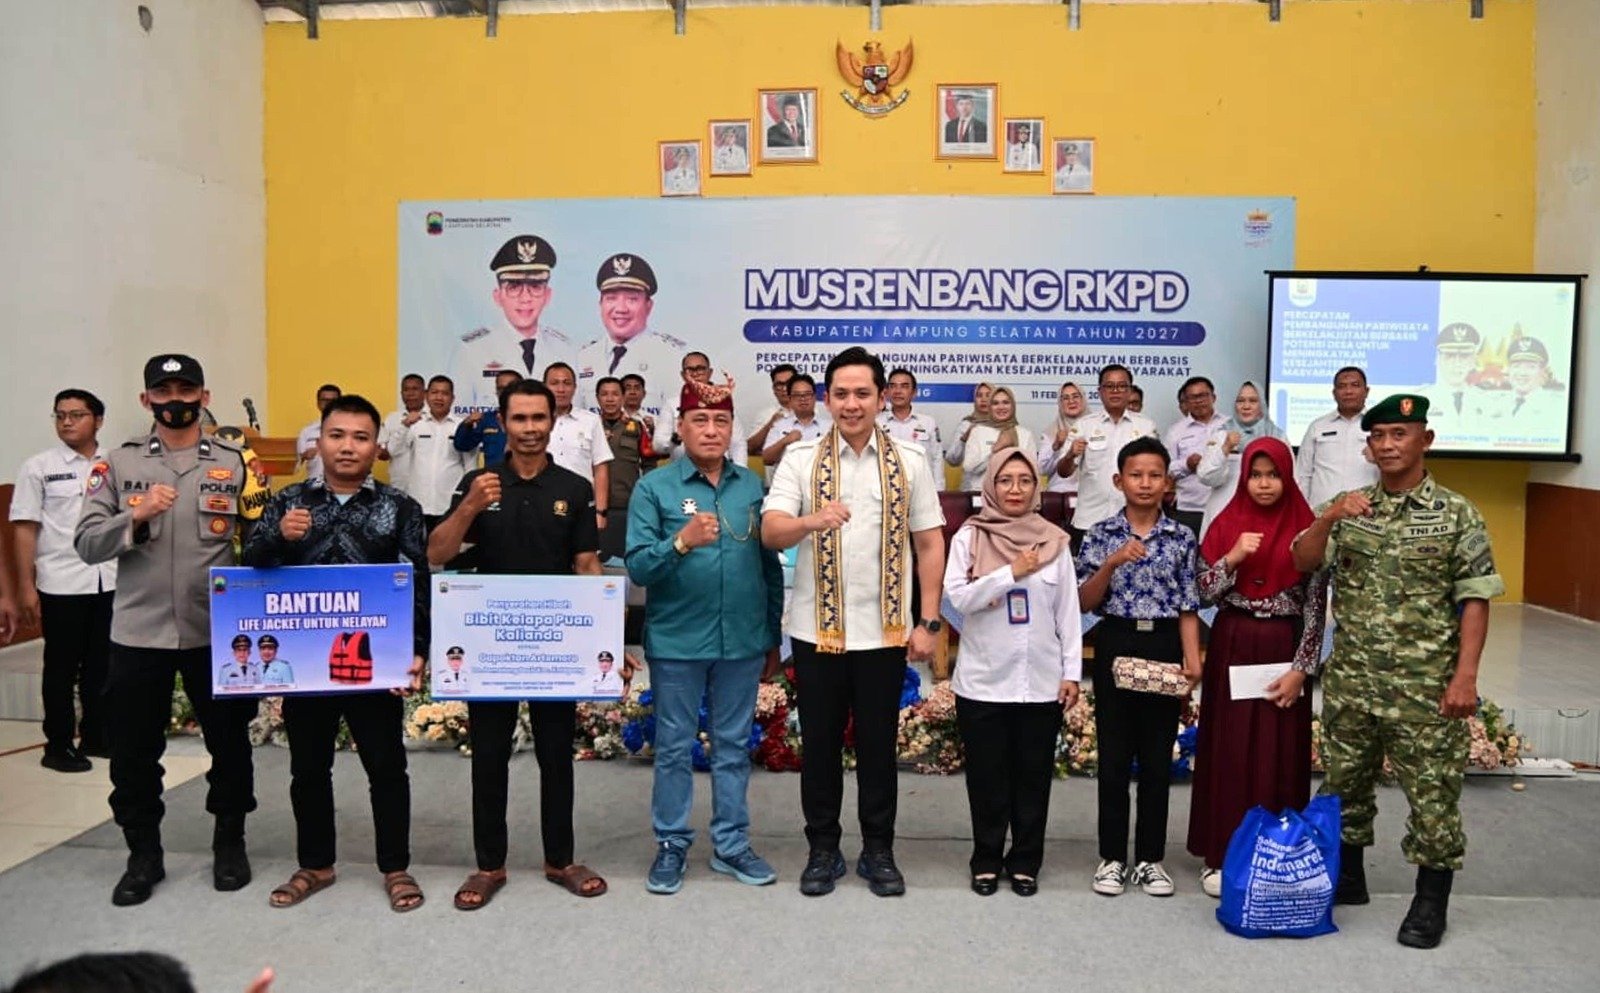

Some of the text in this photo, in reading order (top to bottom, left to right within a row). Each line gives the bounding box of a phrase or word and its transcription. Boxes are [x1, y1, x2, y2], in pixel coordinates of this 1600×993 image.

[745, 268, 1189, 312] MUSRENBANG RKPD
[770, 325, 1180, 340] KABUPATEN LAMPUNG SELATAN TAHUN 2027
[756, 353, 836, 364] PERCEPATAN
[940, 354, 1018, 365] PARIWISATA
[1021, 354, 1126, 365] BERKELANJUTAN
[1129, 355, 1189, 366] BERBASIS
[996, 365, 1099, 377] KESEJAHTERAAN
[200, 482, 237, 494] POLRI
[1410, 525, 1449, 536] TNI AD
[265, 591, 360, 615] BANTUAN
[239, 615, 388, 631] LIFE JACKET UNTUK NELAYAN
[465, 612, 593, 629] Bibit Kelapa Puan
[495, 627, 563, 641] Kalianda
